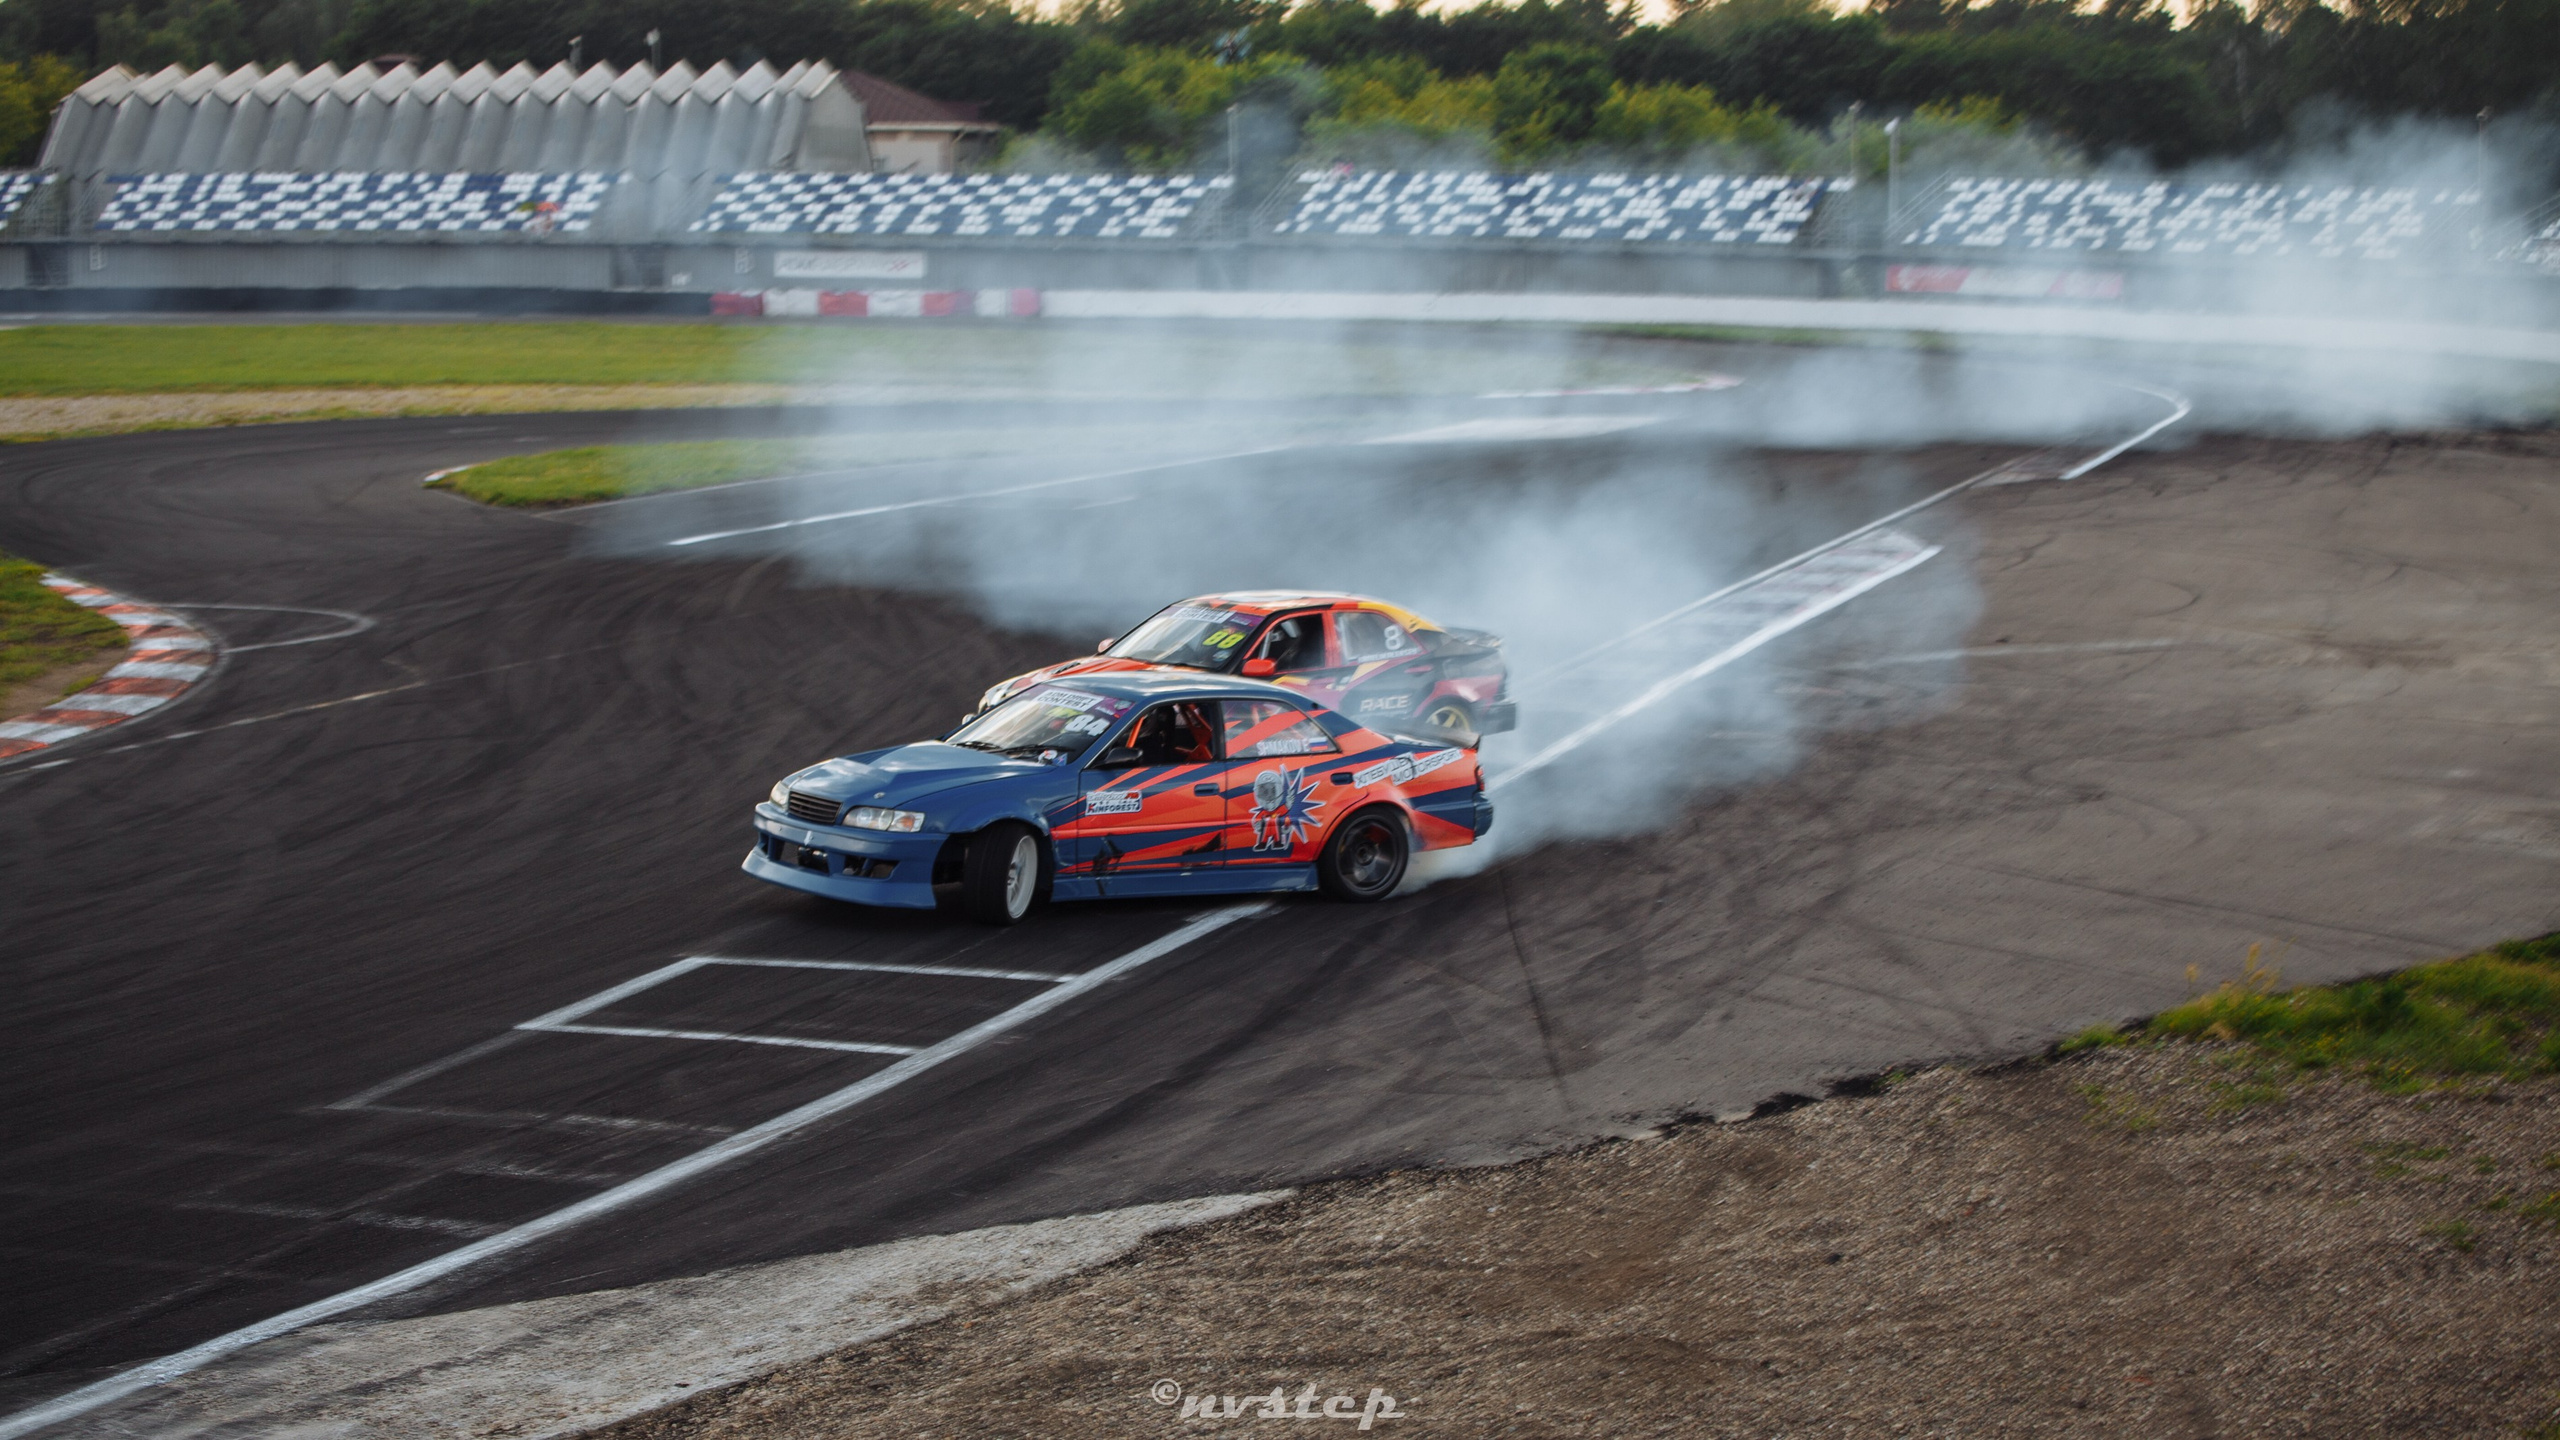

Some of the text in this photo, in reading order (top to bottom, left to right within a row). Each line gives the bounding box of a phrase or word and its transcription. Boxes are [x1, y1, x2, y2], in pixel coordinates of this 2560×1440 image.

[1202, 629, 1246, 649] 88
[1360, 693, 1411, 712] RACE
[1064, 714, 1111, 736] 84
[1393, 750, 1459, 783] MOTORSPORT
